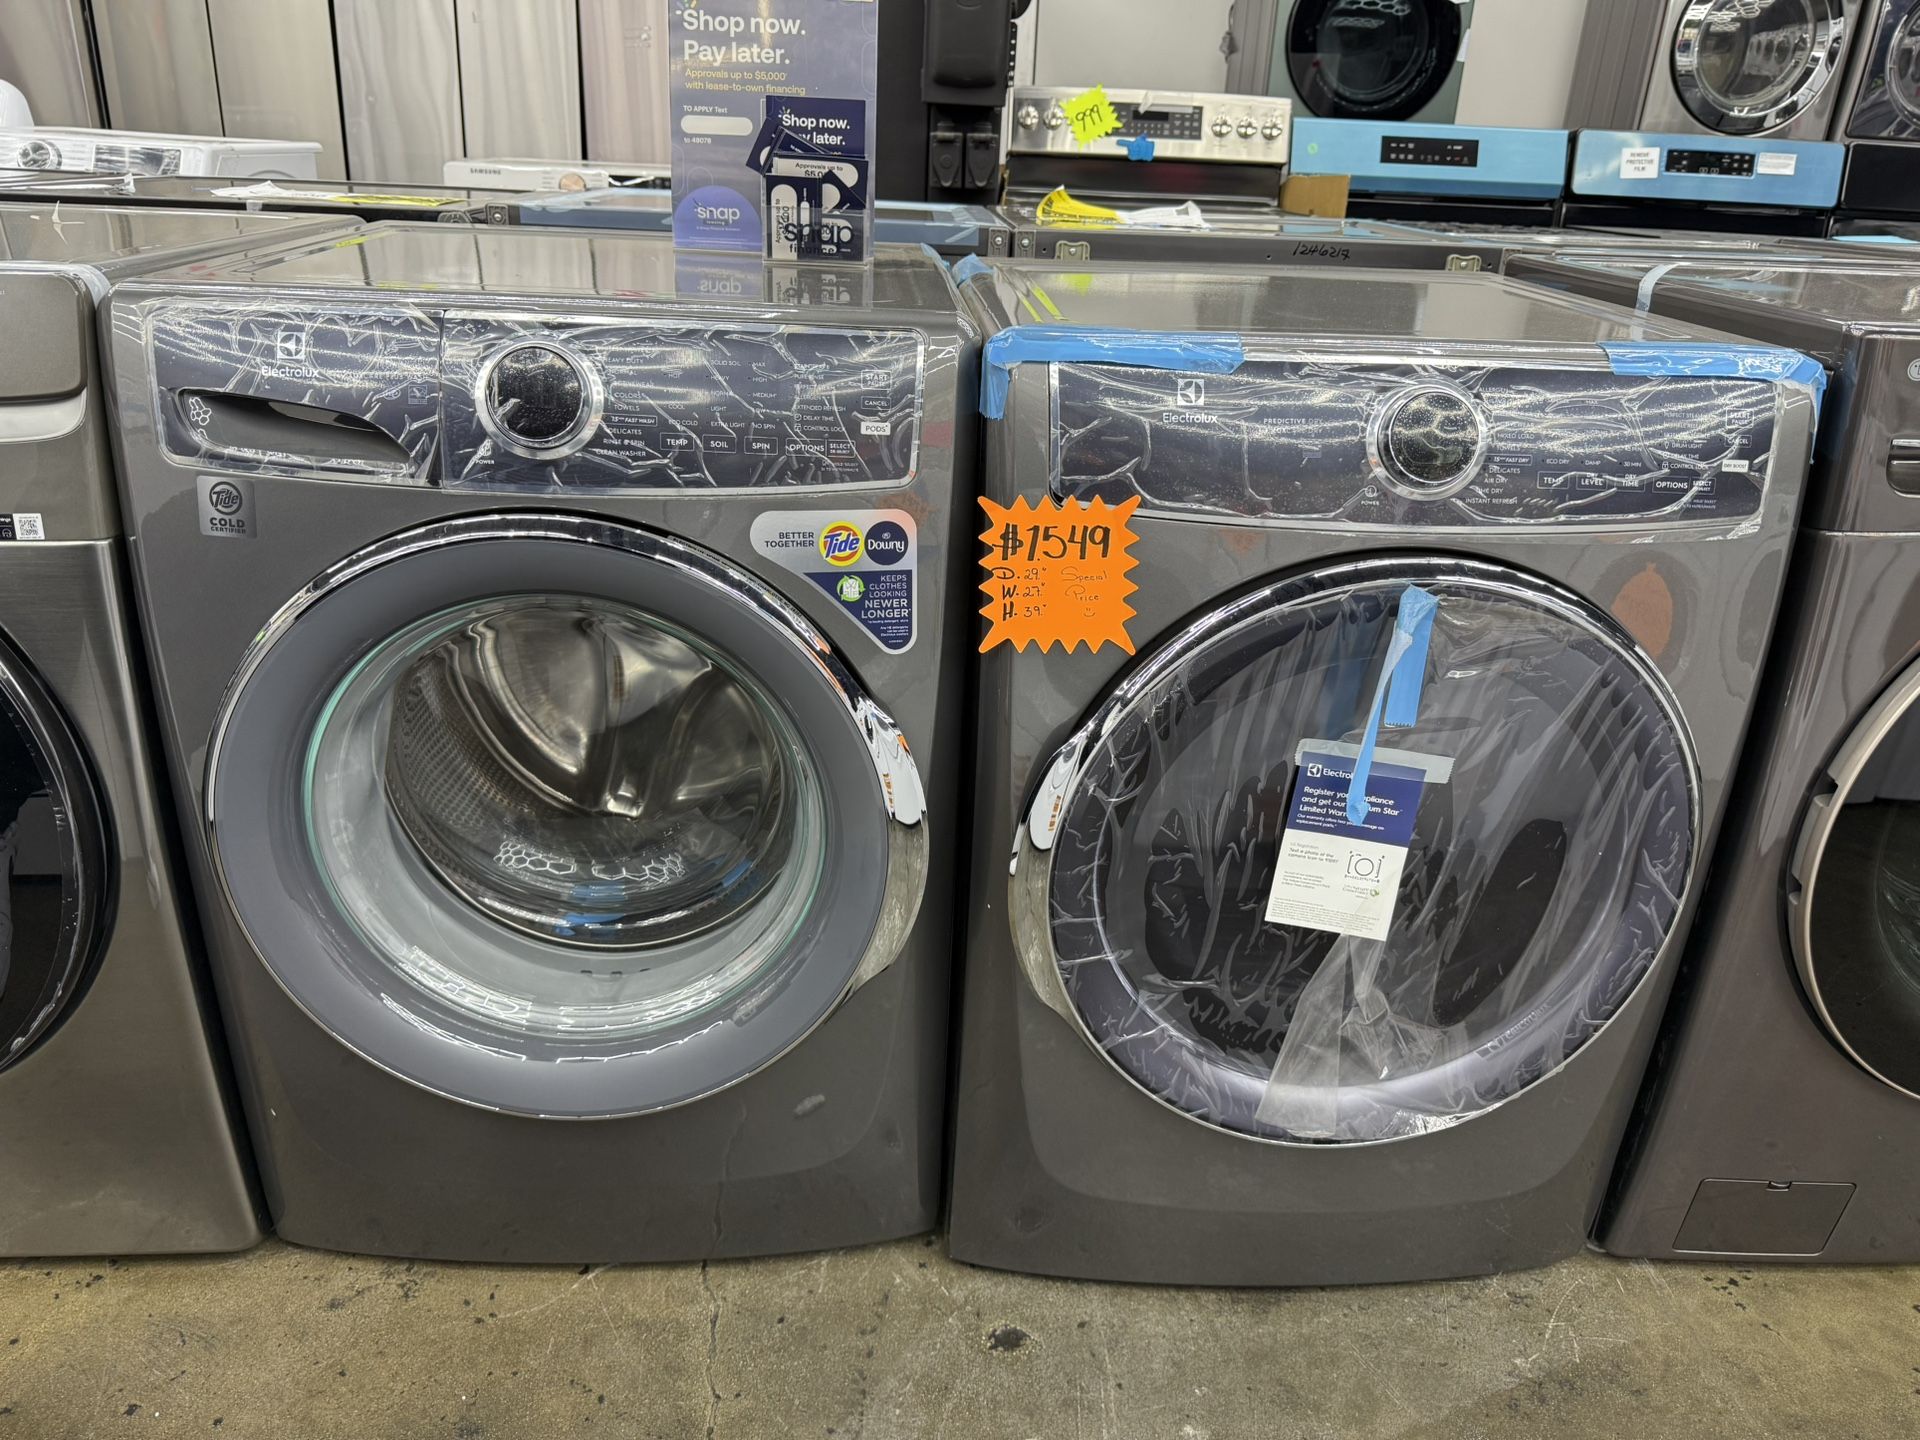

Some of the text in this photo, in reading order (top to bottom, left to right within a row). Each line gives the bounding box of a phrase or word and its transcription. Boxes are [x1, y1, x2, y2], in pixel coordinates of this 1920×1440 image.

[682, 8, 806, 38] Shop now.
[683, 39, 790, 67] Pay later.
[685, 68, 729, 79] Approvals
[730, 71, 742, 80] up
[744, 71, 753, 80] to
[685, 81, 806, 96] with lease-to-own financing
[693, 105, 713, 113] APPLY
[714, 106, 728, 114] Text
[782, 113, 851, 130] Shop now.
[1074, 104, 1103, 132] 999
[813, 131, 846, 146] later.
[697, 206, 741, 224] snap
[261, 365, 320, 379] Electrolux
[864, 373, 888, 381] START
[1162, 412, 1218, 424] Electrolux
[666, 438, 688, 446] TEMP
[752, 442, 771, 450] SPIN
[789, 444, 825, 452] OPTIONS
[1581, 478, 1603, 486] LEVEL
[1655, 481, 1689, 489] OPTIONS
[212, 488, 239, 508] Tide
[209, 517, 246, 528] COLD
[778, 531, 815, 540] BETTER
[765, 540, 815, 548] TOGETHER
[823, 530, 861, 560] Tide
[867, 539, 905, 552] Downy
[880, 574, 907, 582] KEEPS
[1060, 566, 1108, 582] Special
[869, 582, 907, 590] CLOTHES
[869, 590, 907, 598] LOOKING
[1065, 584, 1100, 601] Price
[864, 598, 908, 608] NEWER
[1323, 768, 1353, 780] Electrol
[1304, 785, 1349, 799] Register yo
[1301, 796, 1318, 804] and
[1318, 797, 1332, 806] get
[1299, 804, 1348, 817] Limited Warr
[1382, 807, 1400, 816] Star
